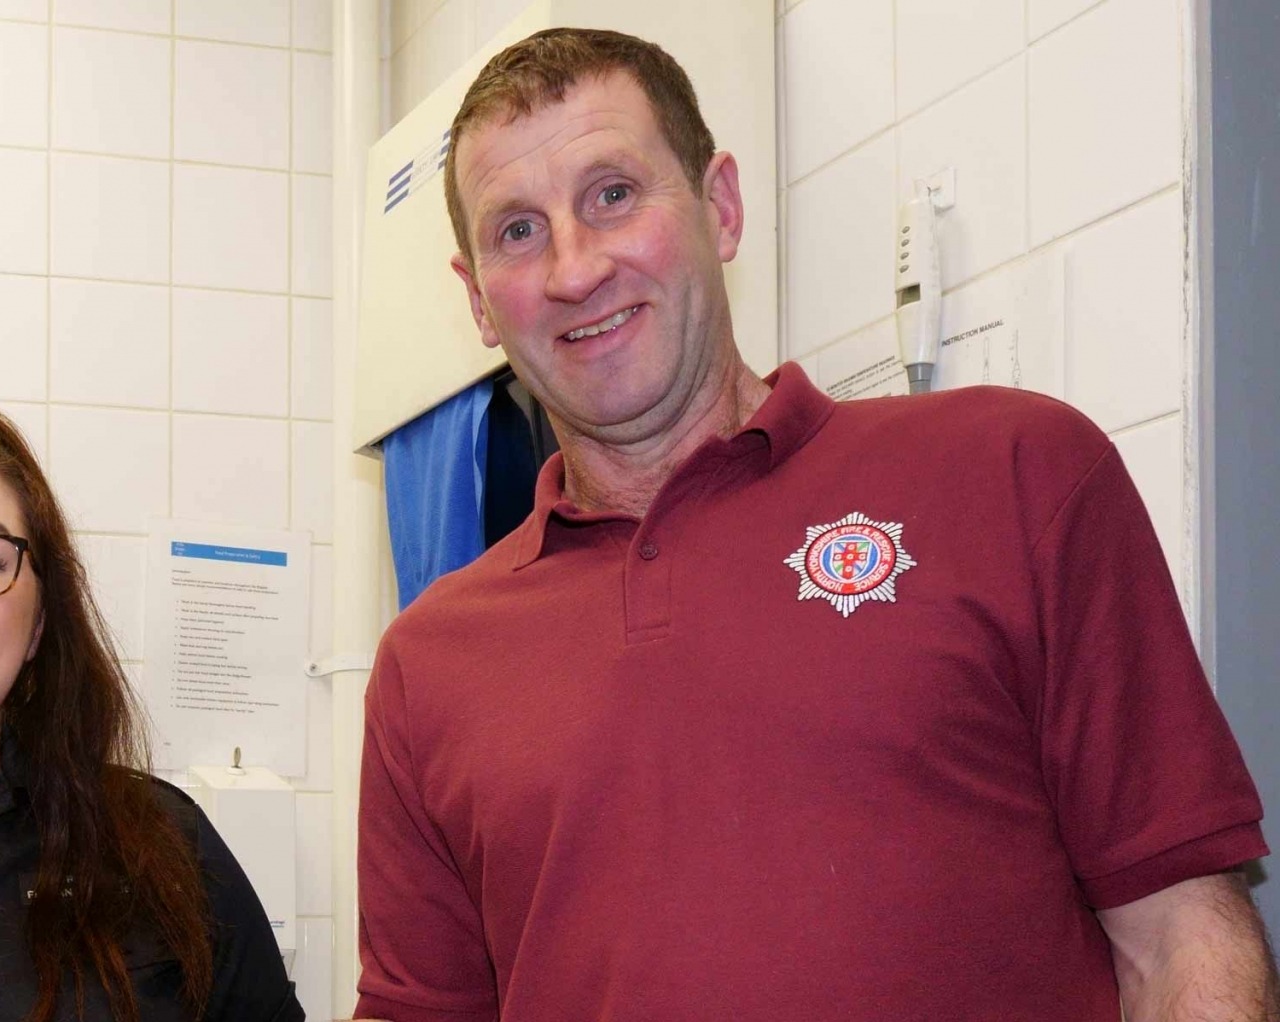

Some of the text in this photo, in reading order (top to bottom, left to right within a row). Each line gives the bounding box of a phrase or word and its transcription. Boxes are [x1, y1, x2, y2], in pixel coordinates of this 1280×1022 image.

[941, 319, 1004, 347] INSTRUCTION MANUAL
[809, 526, 892, 592] NORTH YORKSHIRE FIRE & RESCUE SERVICE
